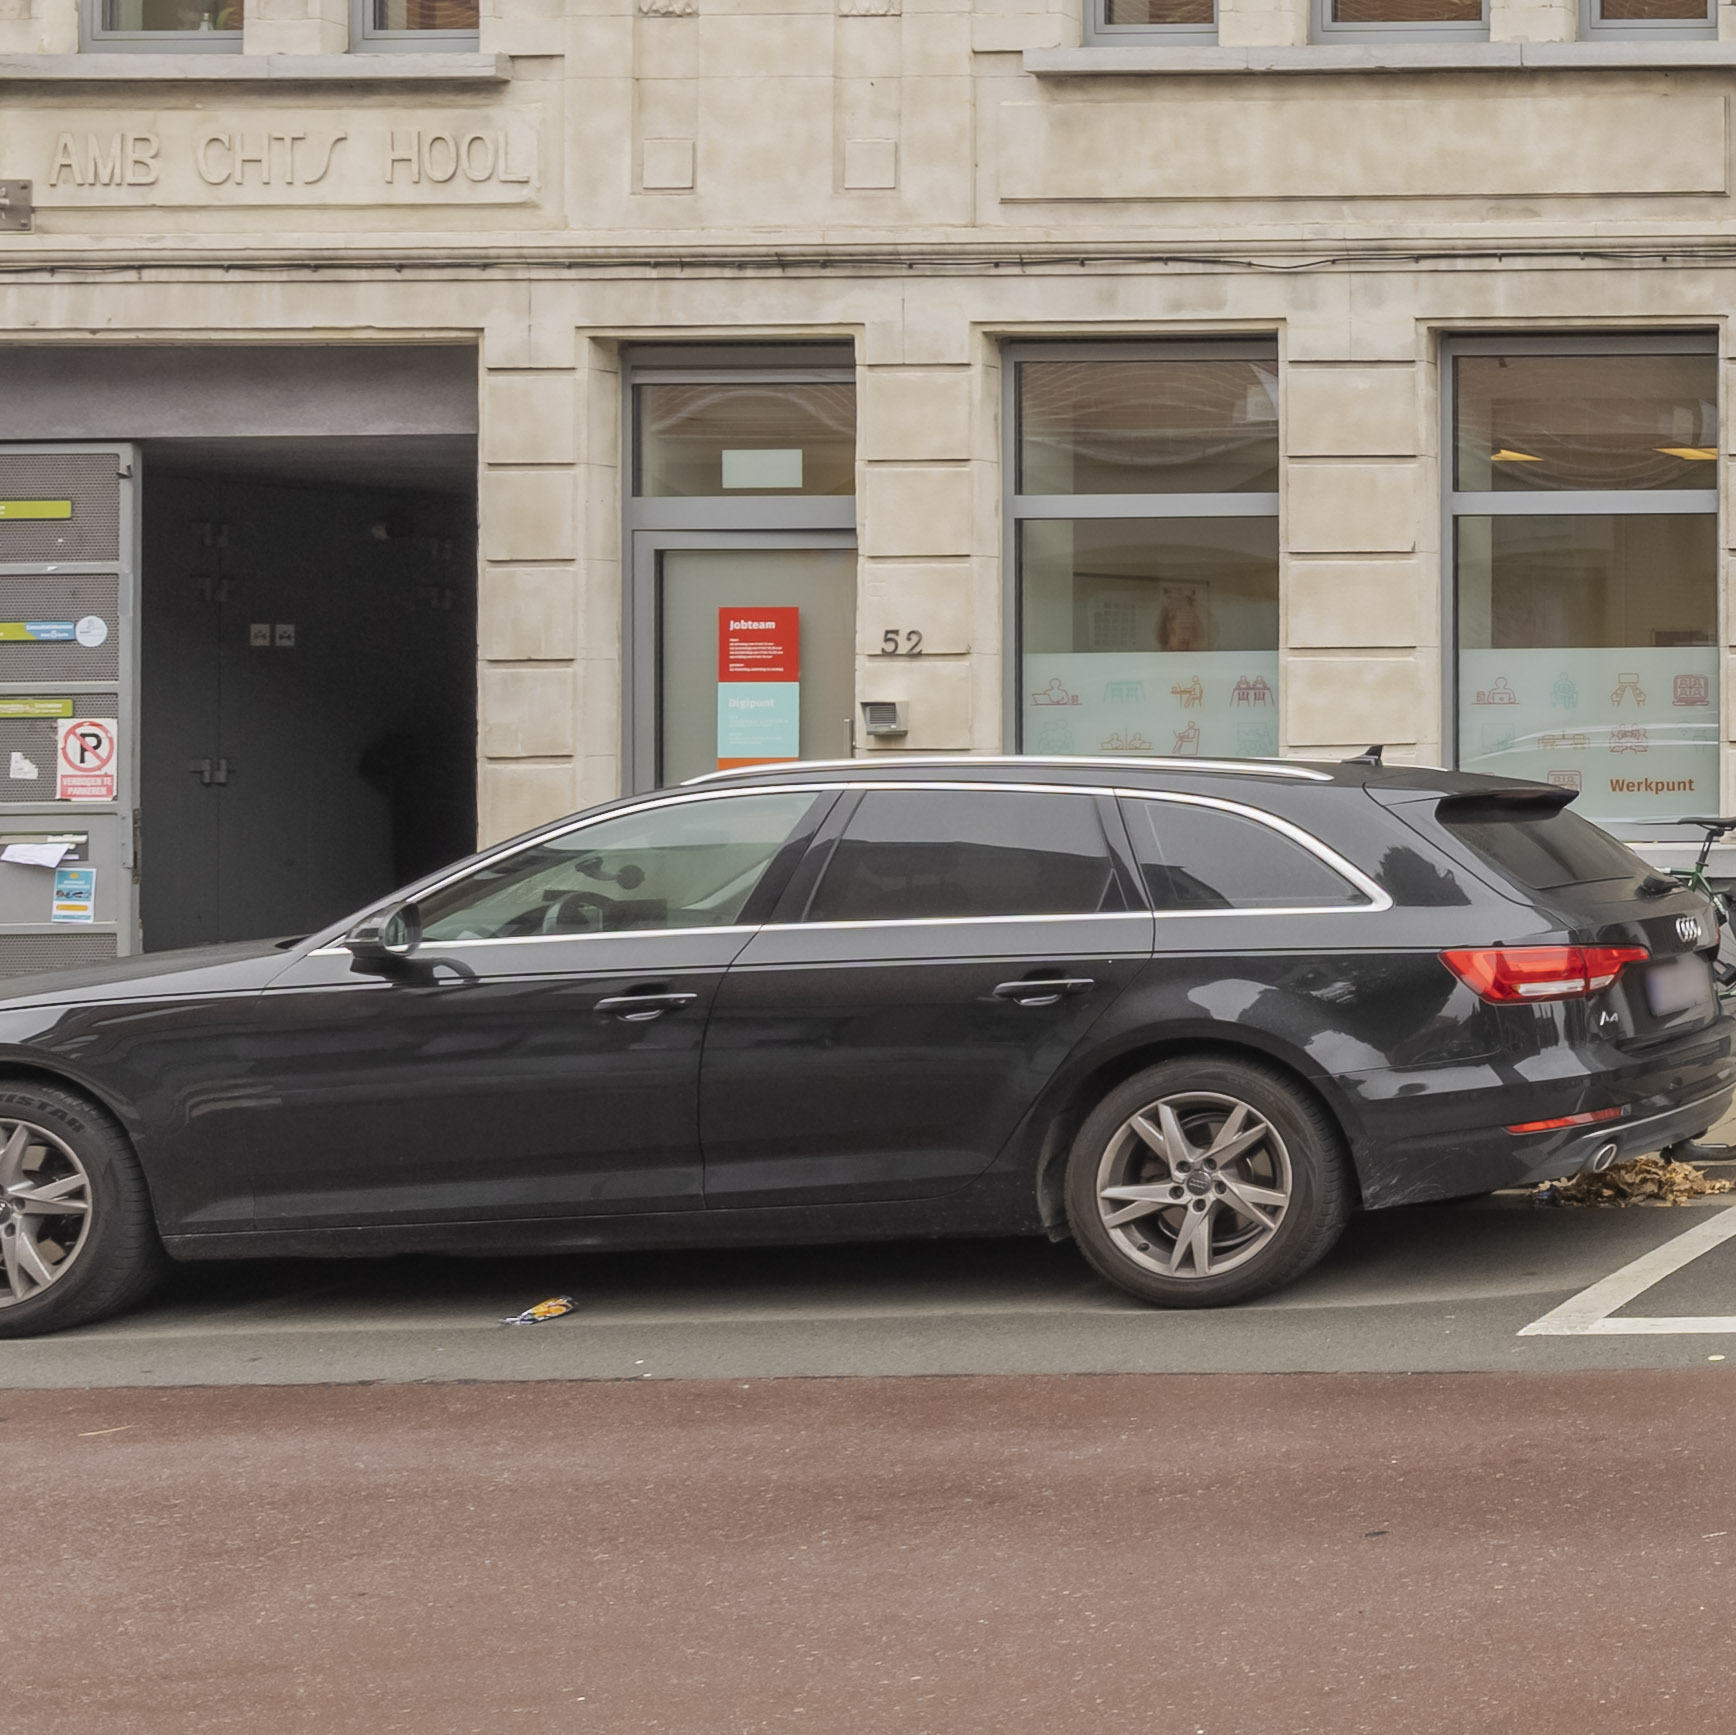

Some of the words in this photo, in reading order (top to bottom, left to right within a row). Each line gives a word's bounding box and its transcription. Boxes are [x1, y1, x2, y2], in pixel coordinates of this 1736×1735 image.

[729, 619, 776, 631] Jobteam
[881, 629, 924, 657] 52
[728, 697, 776, 710] Digipunt
[1610, 778, 1695, 795] Werkpunt
